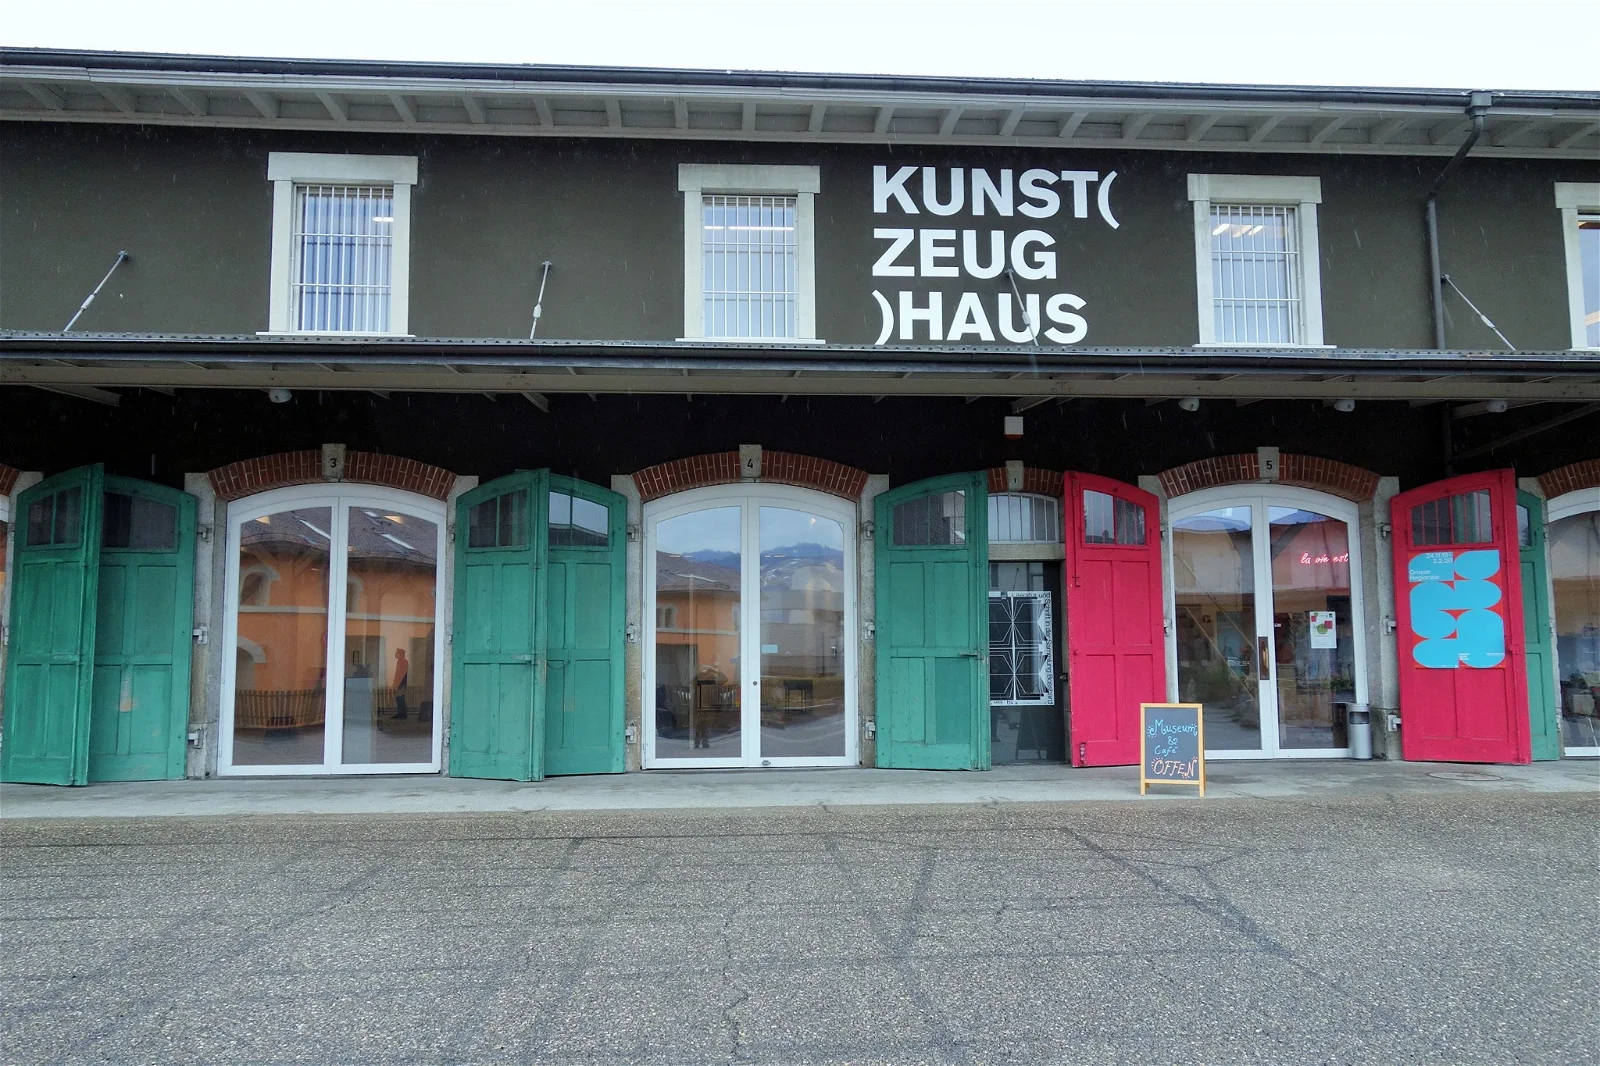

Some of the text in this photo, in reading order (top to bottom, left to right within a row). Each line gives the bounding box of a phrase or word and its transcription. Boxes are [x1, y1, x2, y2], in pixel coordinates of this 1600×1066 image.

[873, 165, 1120, 230] KUNST(
[872, 228, 1057, 280] ZEUG
[872, 289, 1088, 346] )HAUS
[330, 457, 337, 468] 3
[747, 458, 754, 469] 4
[1266, 460, 1273, 470] 5
[1301, 553, 1349, 564] la vie est
[1149, 719, 1198, 737] Museum
[1167, 736, 1178, 745] &
[1154, 744, 1178, 757] Café
[1153, 758, 1198, 777] OFFEN
